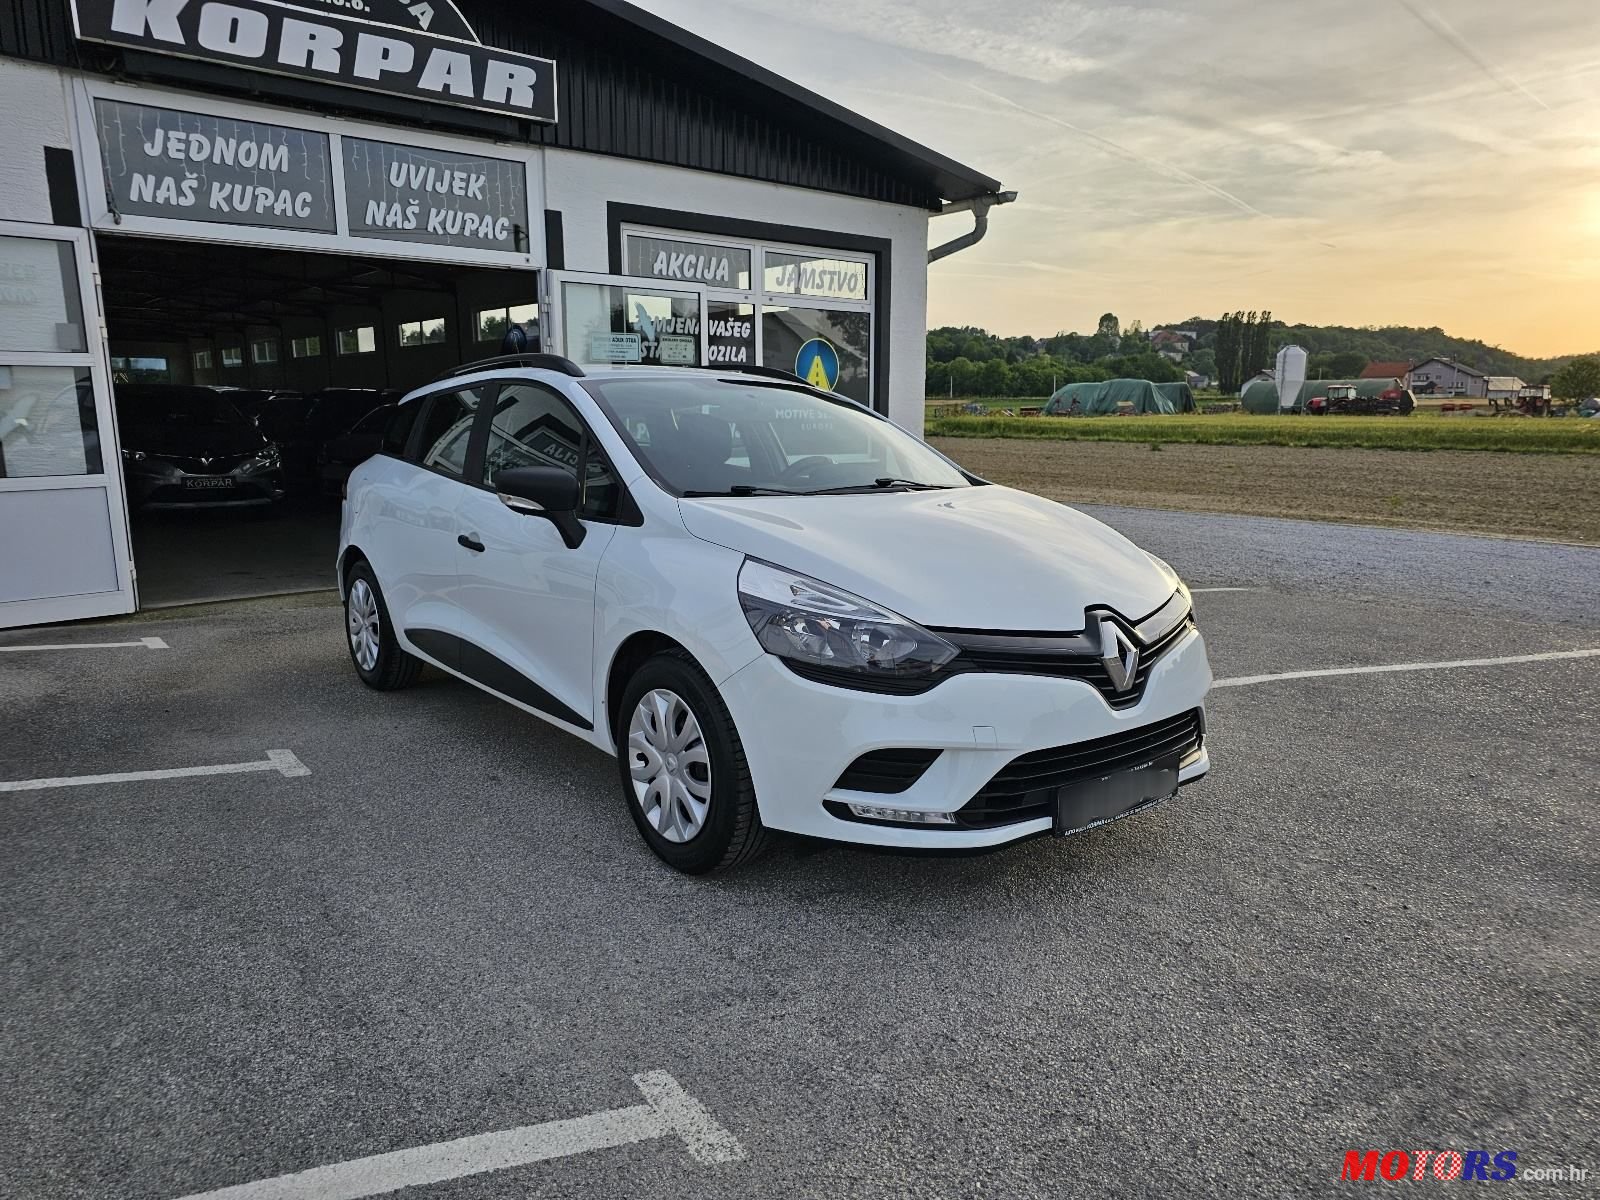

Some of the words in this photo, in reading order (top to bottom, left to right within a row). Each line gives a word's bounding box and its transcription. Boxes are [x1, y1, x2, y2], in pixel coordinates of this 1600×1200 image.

[110, 0, 538, 109] KORPAR
[143, 128, 289, 173] JEDNOM
[129, 171, 198, 207] NAŠ
[209, 181, 312, 218] KUPAC
[389, 162, 486, 201] UVIJEK
[365, 198, 420, 230] NAŠ
[427, 207, 510, 241] KUPAC
[653, 250, 729, 282] AKCIJA
[775, 264, 859, 294] JAMSTVO
[709, 318, 751, 338] VAŠEG
[708, 345, 747, 363] OZILA
[186, 478, 233, 488] KORPAR
